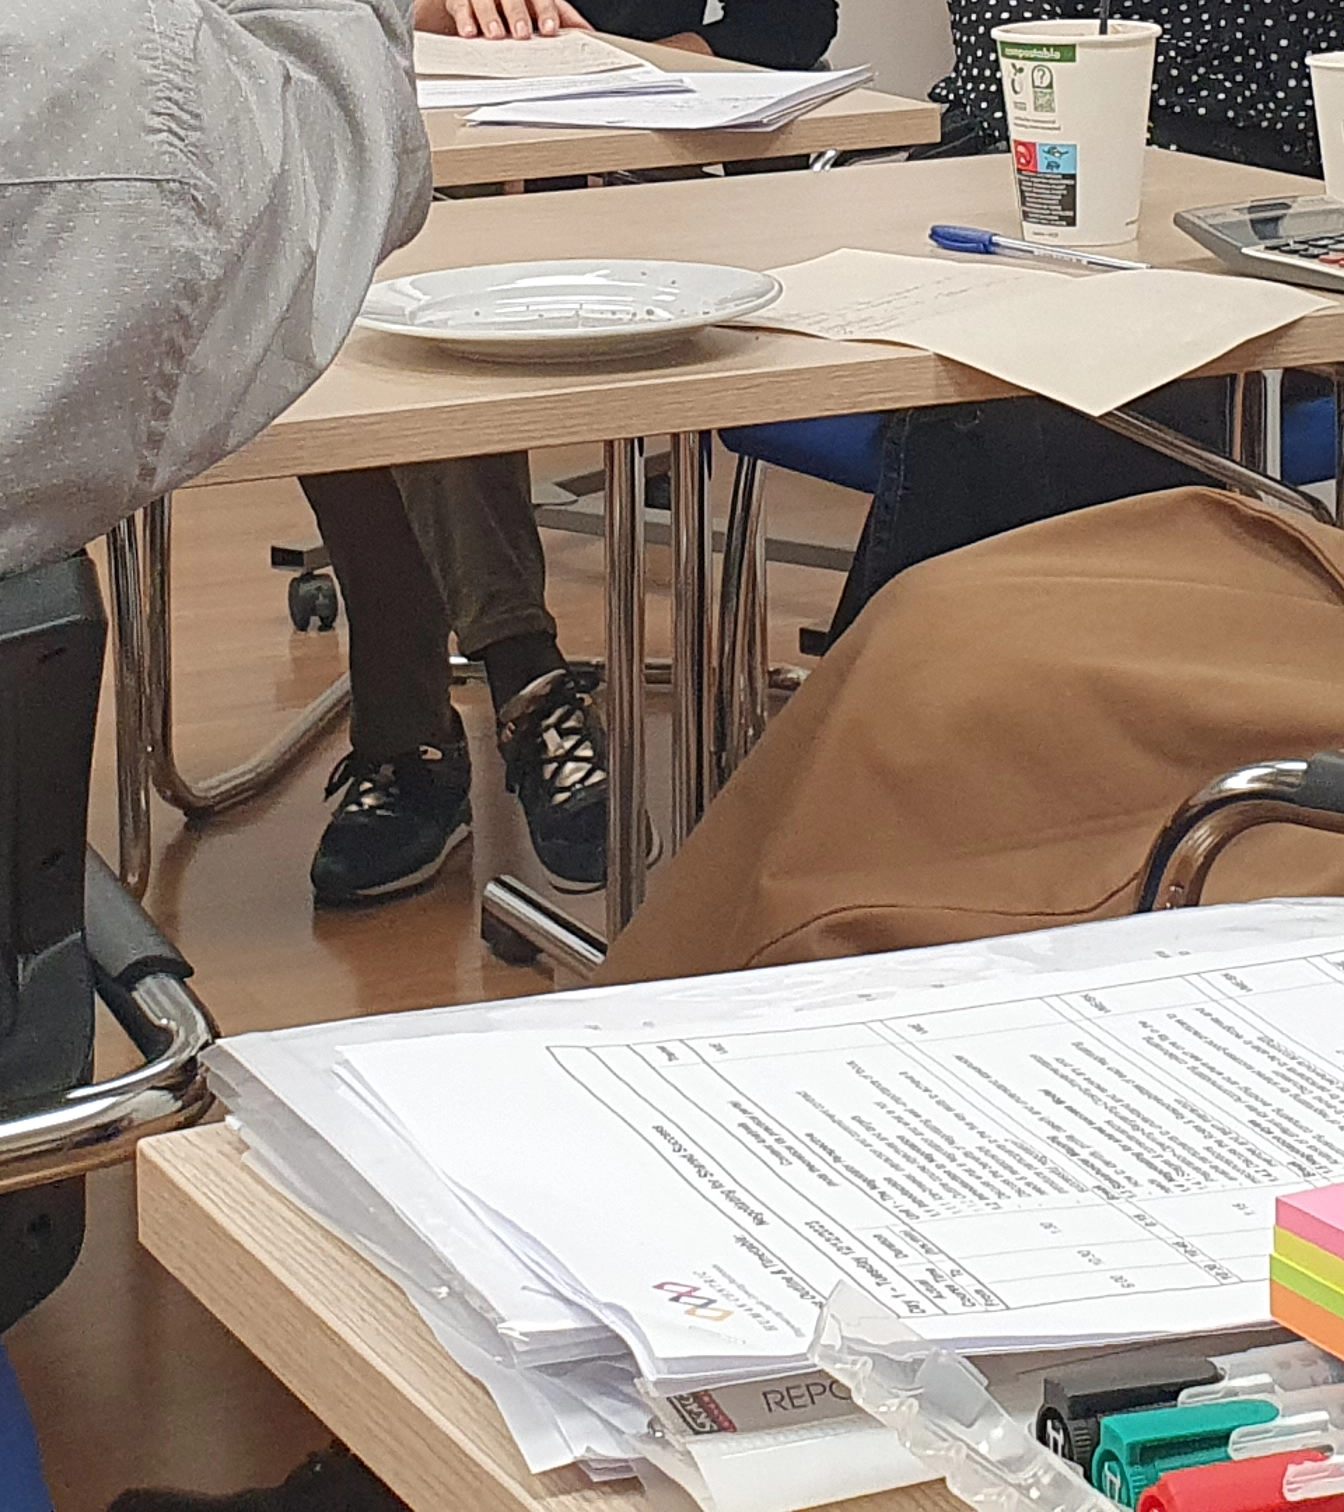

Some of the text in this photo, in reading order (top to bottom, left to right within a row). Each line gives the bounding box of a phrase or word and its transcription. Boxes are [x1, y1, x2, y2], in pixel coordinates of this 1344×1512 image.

[651, 1125, 687, 1153] Success
[681, 1153, 713, 1178] Shared
[852, 1256, 890, 1286] Tuesday
[903, 1300, 926, 1313] Day
